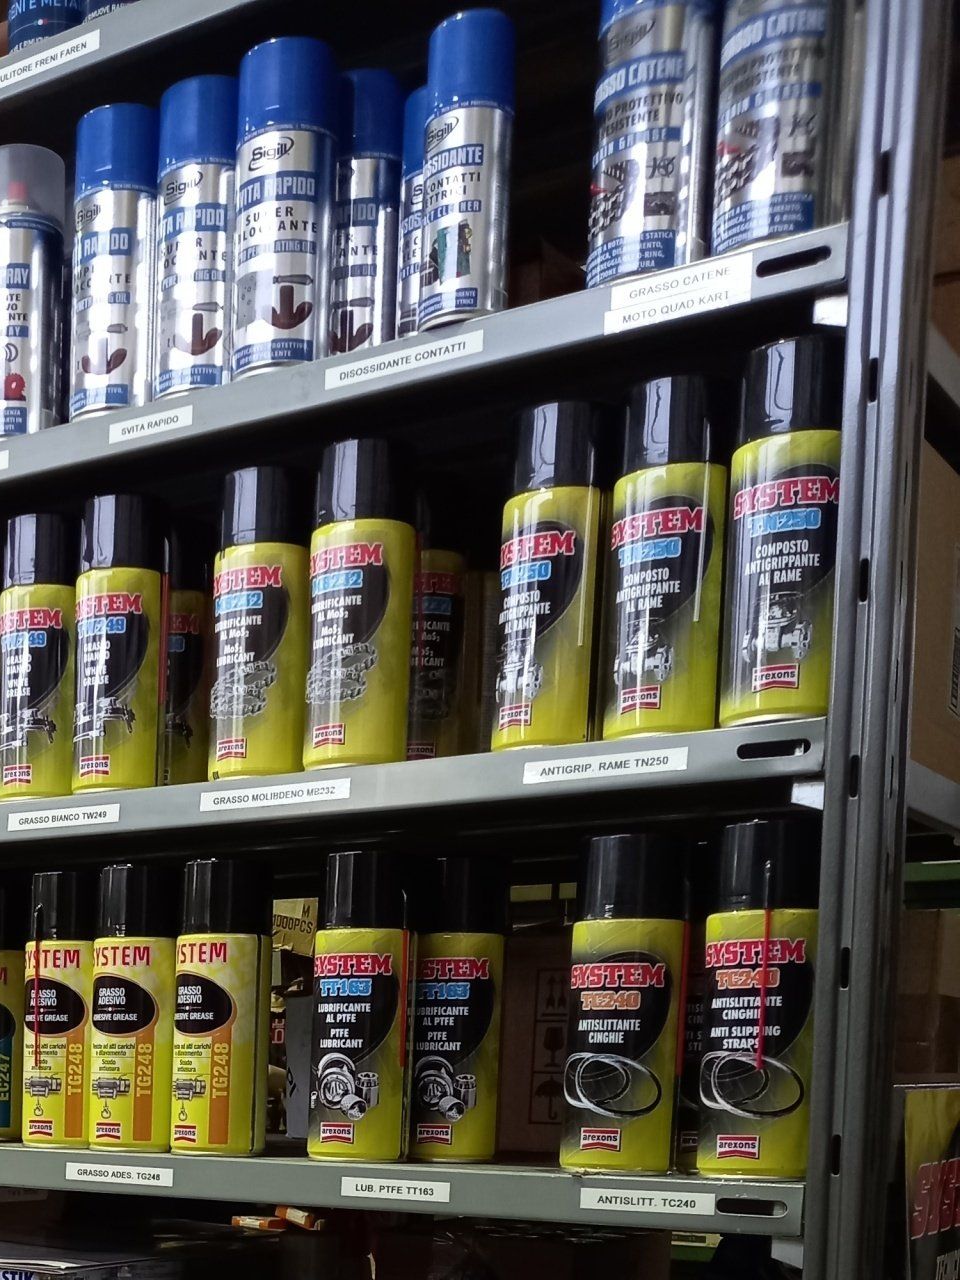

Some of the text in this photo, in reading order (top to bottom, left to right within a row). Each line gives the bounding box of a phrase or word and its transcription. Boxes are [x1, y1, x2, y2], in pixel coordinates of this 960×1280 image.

[34, 53, 58, 68] FRENI
[59, 41, 86, 58] FAREN
[629, 267, 730, 298] GRASSO CATENE
[339, 341, 465, 380] DISOSSIDANTE CONTATTI
[120, 415, 178, 435] SVITA RAPIDO
[734, 476, 840, 520] SYSTEM
[748, 507, 822, 538] TN250
[755, 540, 809, 558] COMPOSTO
[745, 552, 820, 576] ANTIGRIPPANTE
[759, 569, 802, 586] AL RAME
[754, 669, 796, 682] arexons
[539, 756, 668, 775] ANTIGRIP. RAME TN250
[213, 794, 249, 805] GRASSO
[251, 789, 303, 801] MOLIBDENO
[18, 810, 106, 825] GRASSO BIANCO TW249
[570, 963, 666, 989] SYSTEM
[581, 991, 642, 1010] TC240
[578, 1019, 641, 1032] ANTISLITTANTE
[588, 1031, 625, 1044] CINGHIE
[582, 1133, 618, 1142] arexons
[76, 1168, 160, 1180] GRASSO ADES. TG248
[355, 1183, 433, 1195] LUB. PTFE TT163
[597, 1195, 695, 1208] ANTISLITT. TC240
